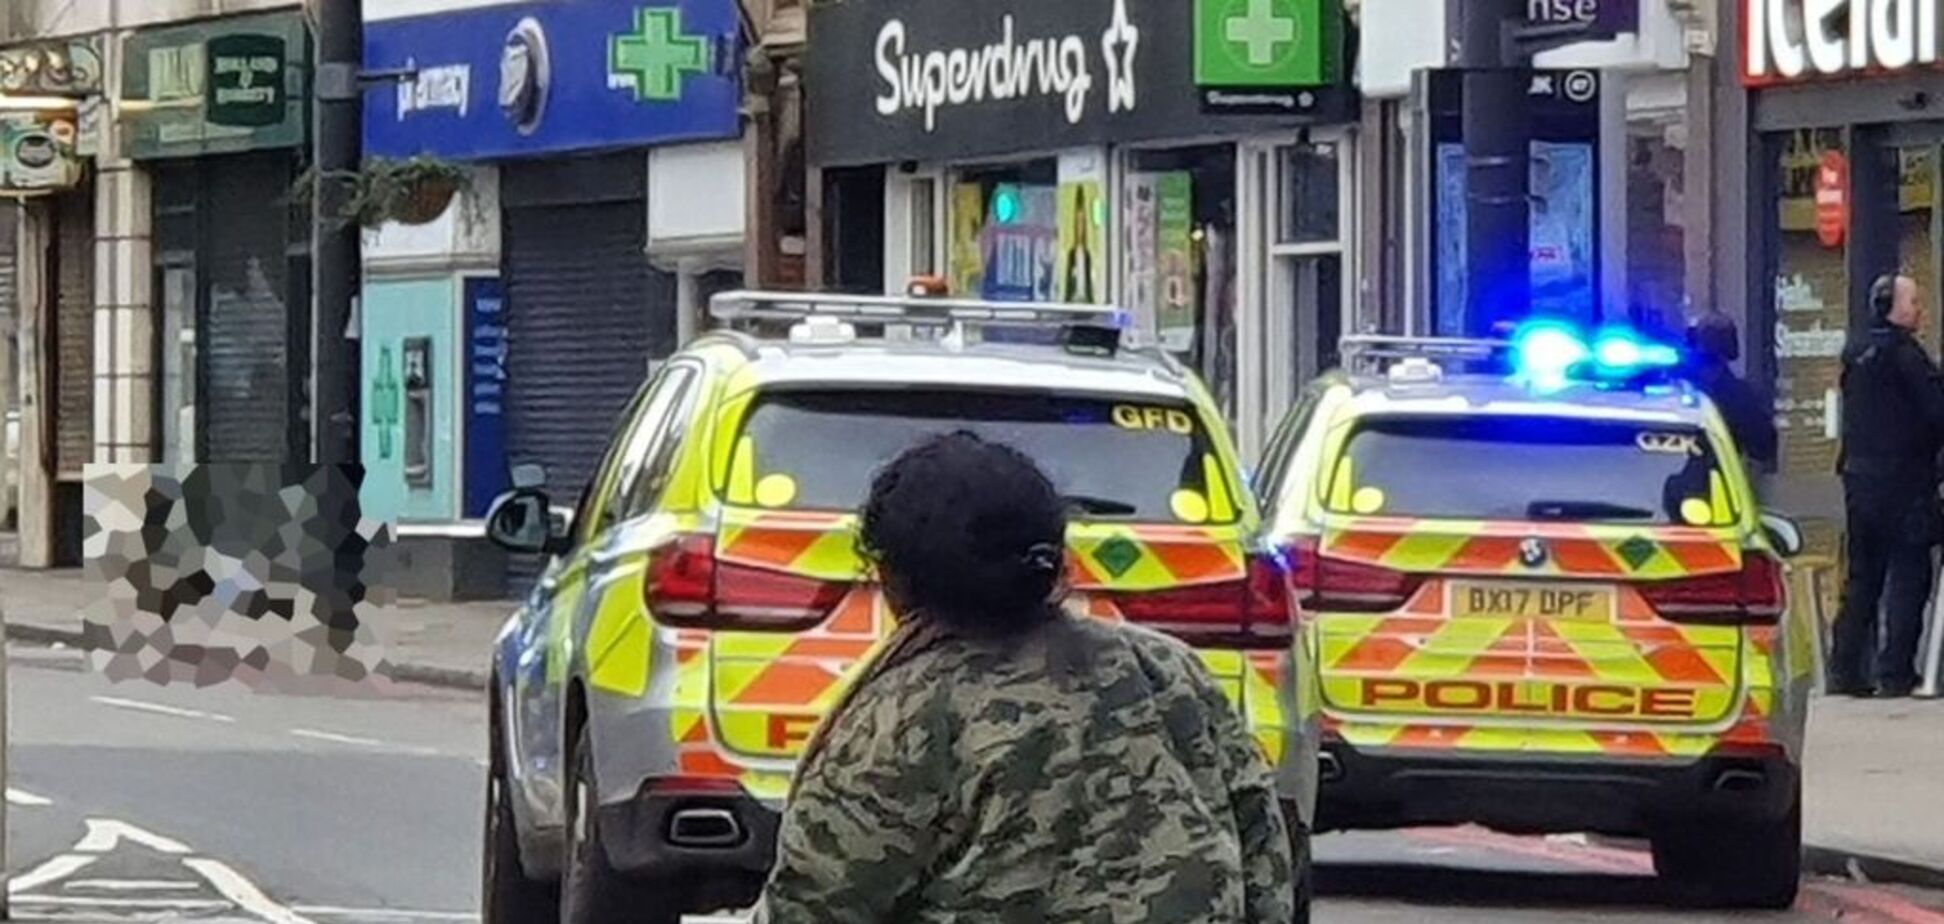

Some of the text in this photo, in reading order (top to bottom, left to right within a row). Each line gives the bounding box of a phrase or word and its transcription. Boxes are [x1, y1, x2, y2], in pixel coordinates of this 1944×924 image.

[875, 14, 1092, 132] Superdrug
[1112, 404, 1193, 434] GFD
[1635, 431, 1703, 457] GZK
[1469, 587, 1593, 616] BX17 DPF
[1360, 678, 1696, 717] POLICE
